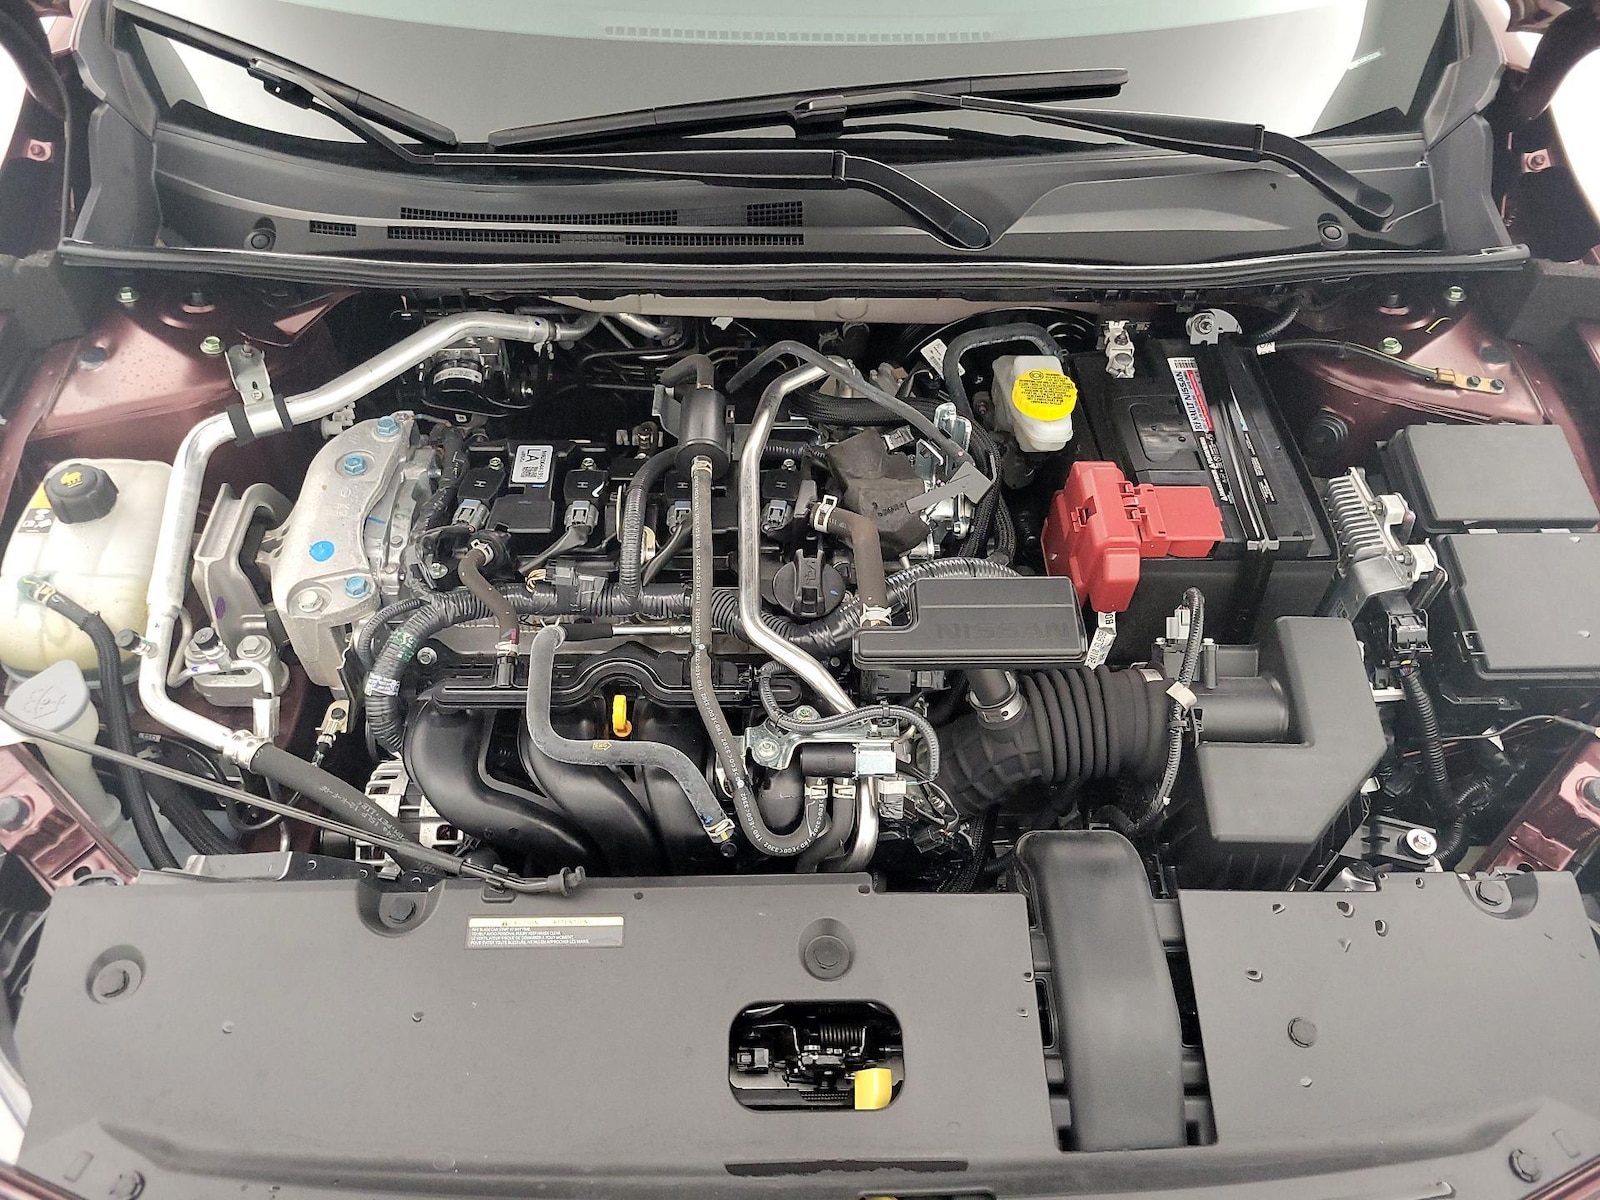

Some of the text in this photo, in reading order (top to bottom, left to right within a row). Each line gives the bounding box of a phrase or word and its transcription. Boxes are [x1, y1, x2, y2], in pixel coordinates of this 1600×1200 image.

[1176, 371, 1191, 401] NISSAN
[526, 448, 541, 462] LA
[936, 622, 1070, 640] NISSAN
